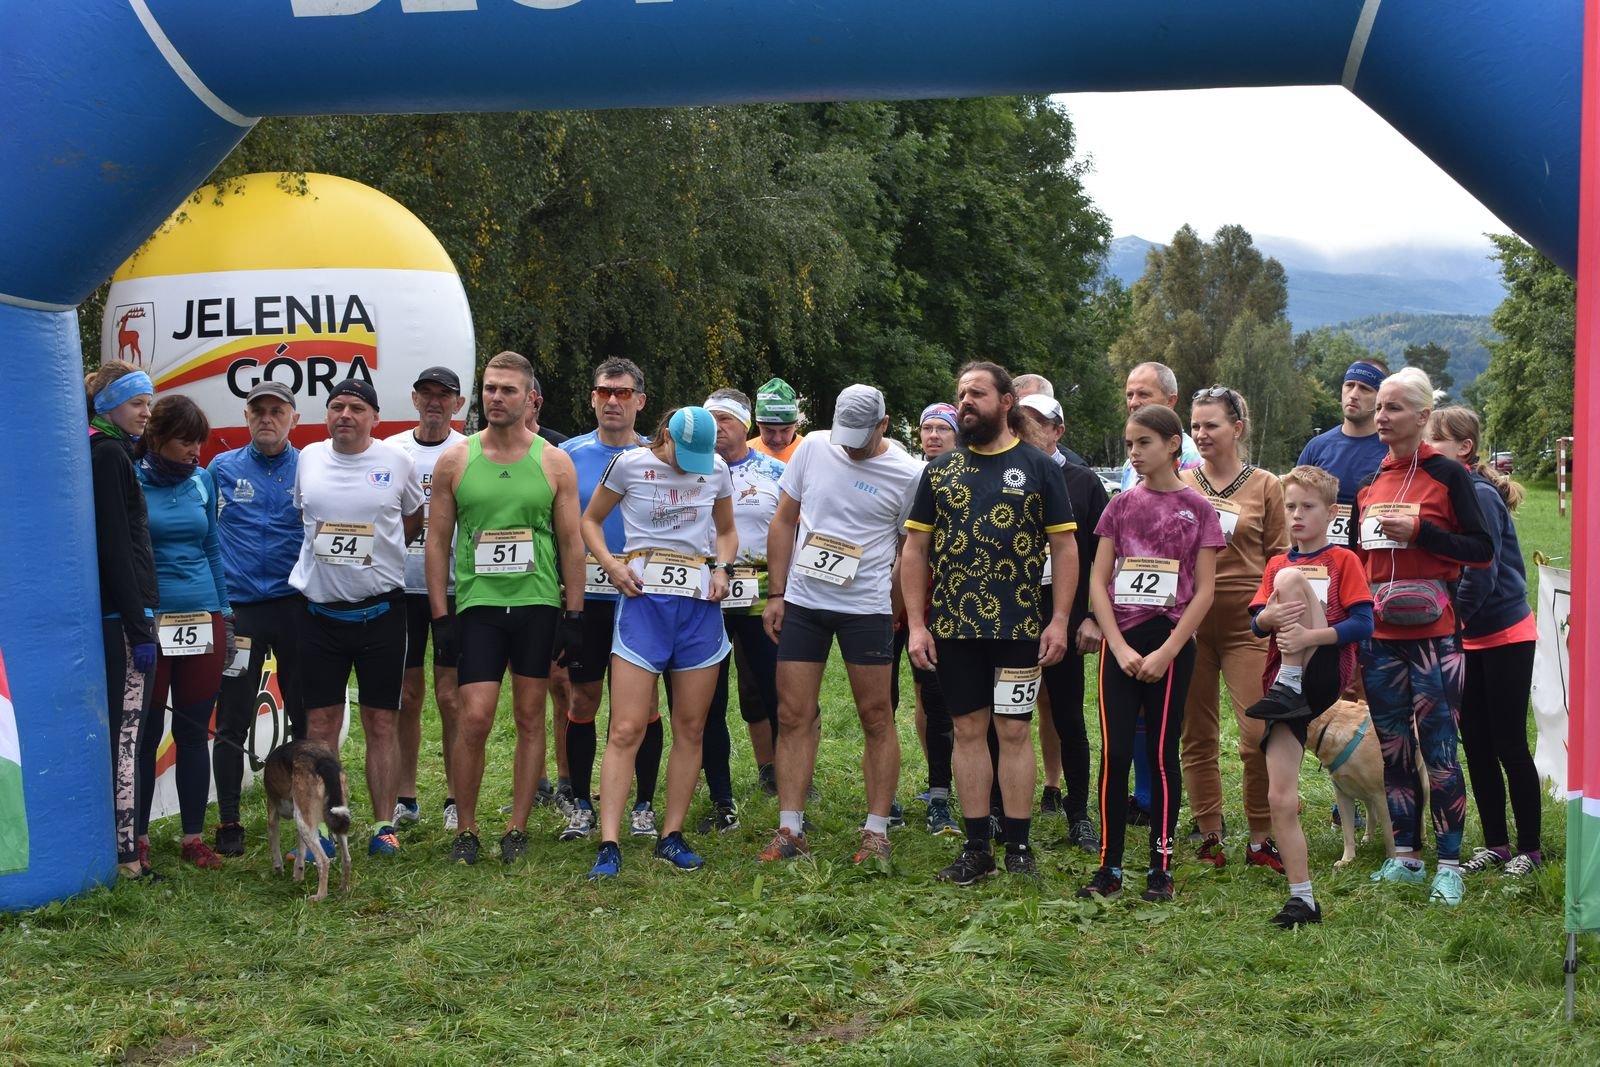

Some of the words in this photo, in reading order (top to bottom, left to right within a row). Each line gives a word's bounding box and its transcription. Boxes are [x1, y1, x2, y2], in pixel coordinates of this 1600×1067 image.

[172, 295, 376, 340] JELENIA
[226, 342, 375, 399] GÓRA
[1374, 522, 1384, 538] 4
[330, 536, 358, 555] 54
[492, 544, 517, 563] 51
[814, 551, 845, 572] 37
[660, 566, 687, 586] 53
[1130, 572, 1160, 594] 42
[172, 626, 198, 645] 45
[1011, 682, 1037, 704] 55
